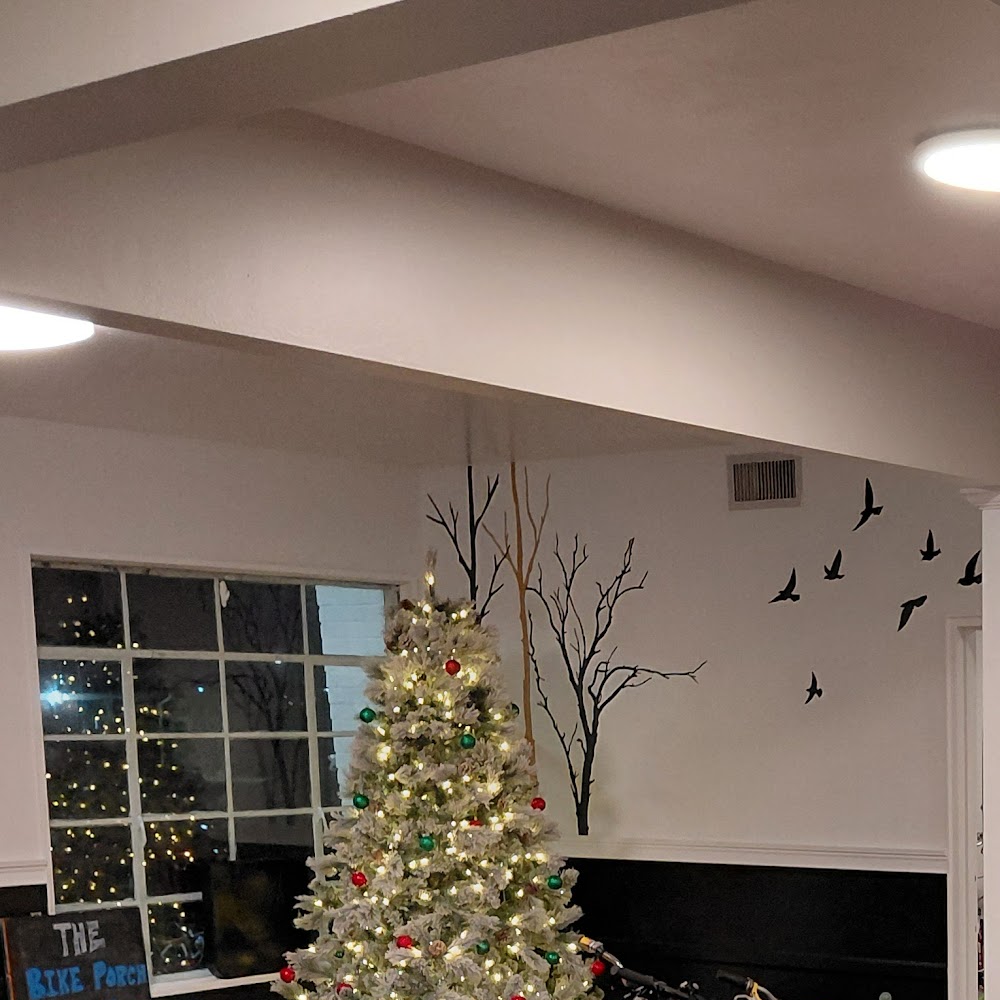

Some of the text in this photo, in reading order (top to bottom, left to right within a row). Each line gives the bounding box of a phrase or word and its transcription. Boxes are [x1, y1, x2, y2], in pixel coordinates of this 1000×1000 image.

[53, 920, 106, 957] THE
[25, 961, 148, 1000] BIKE PORCH
